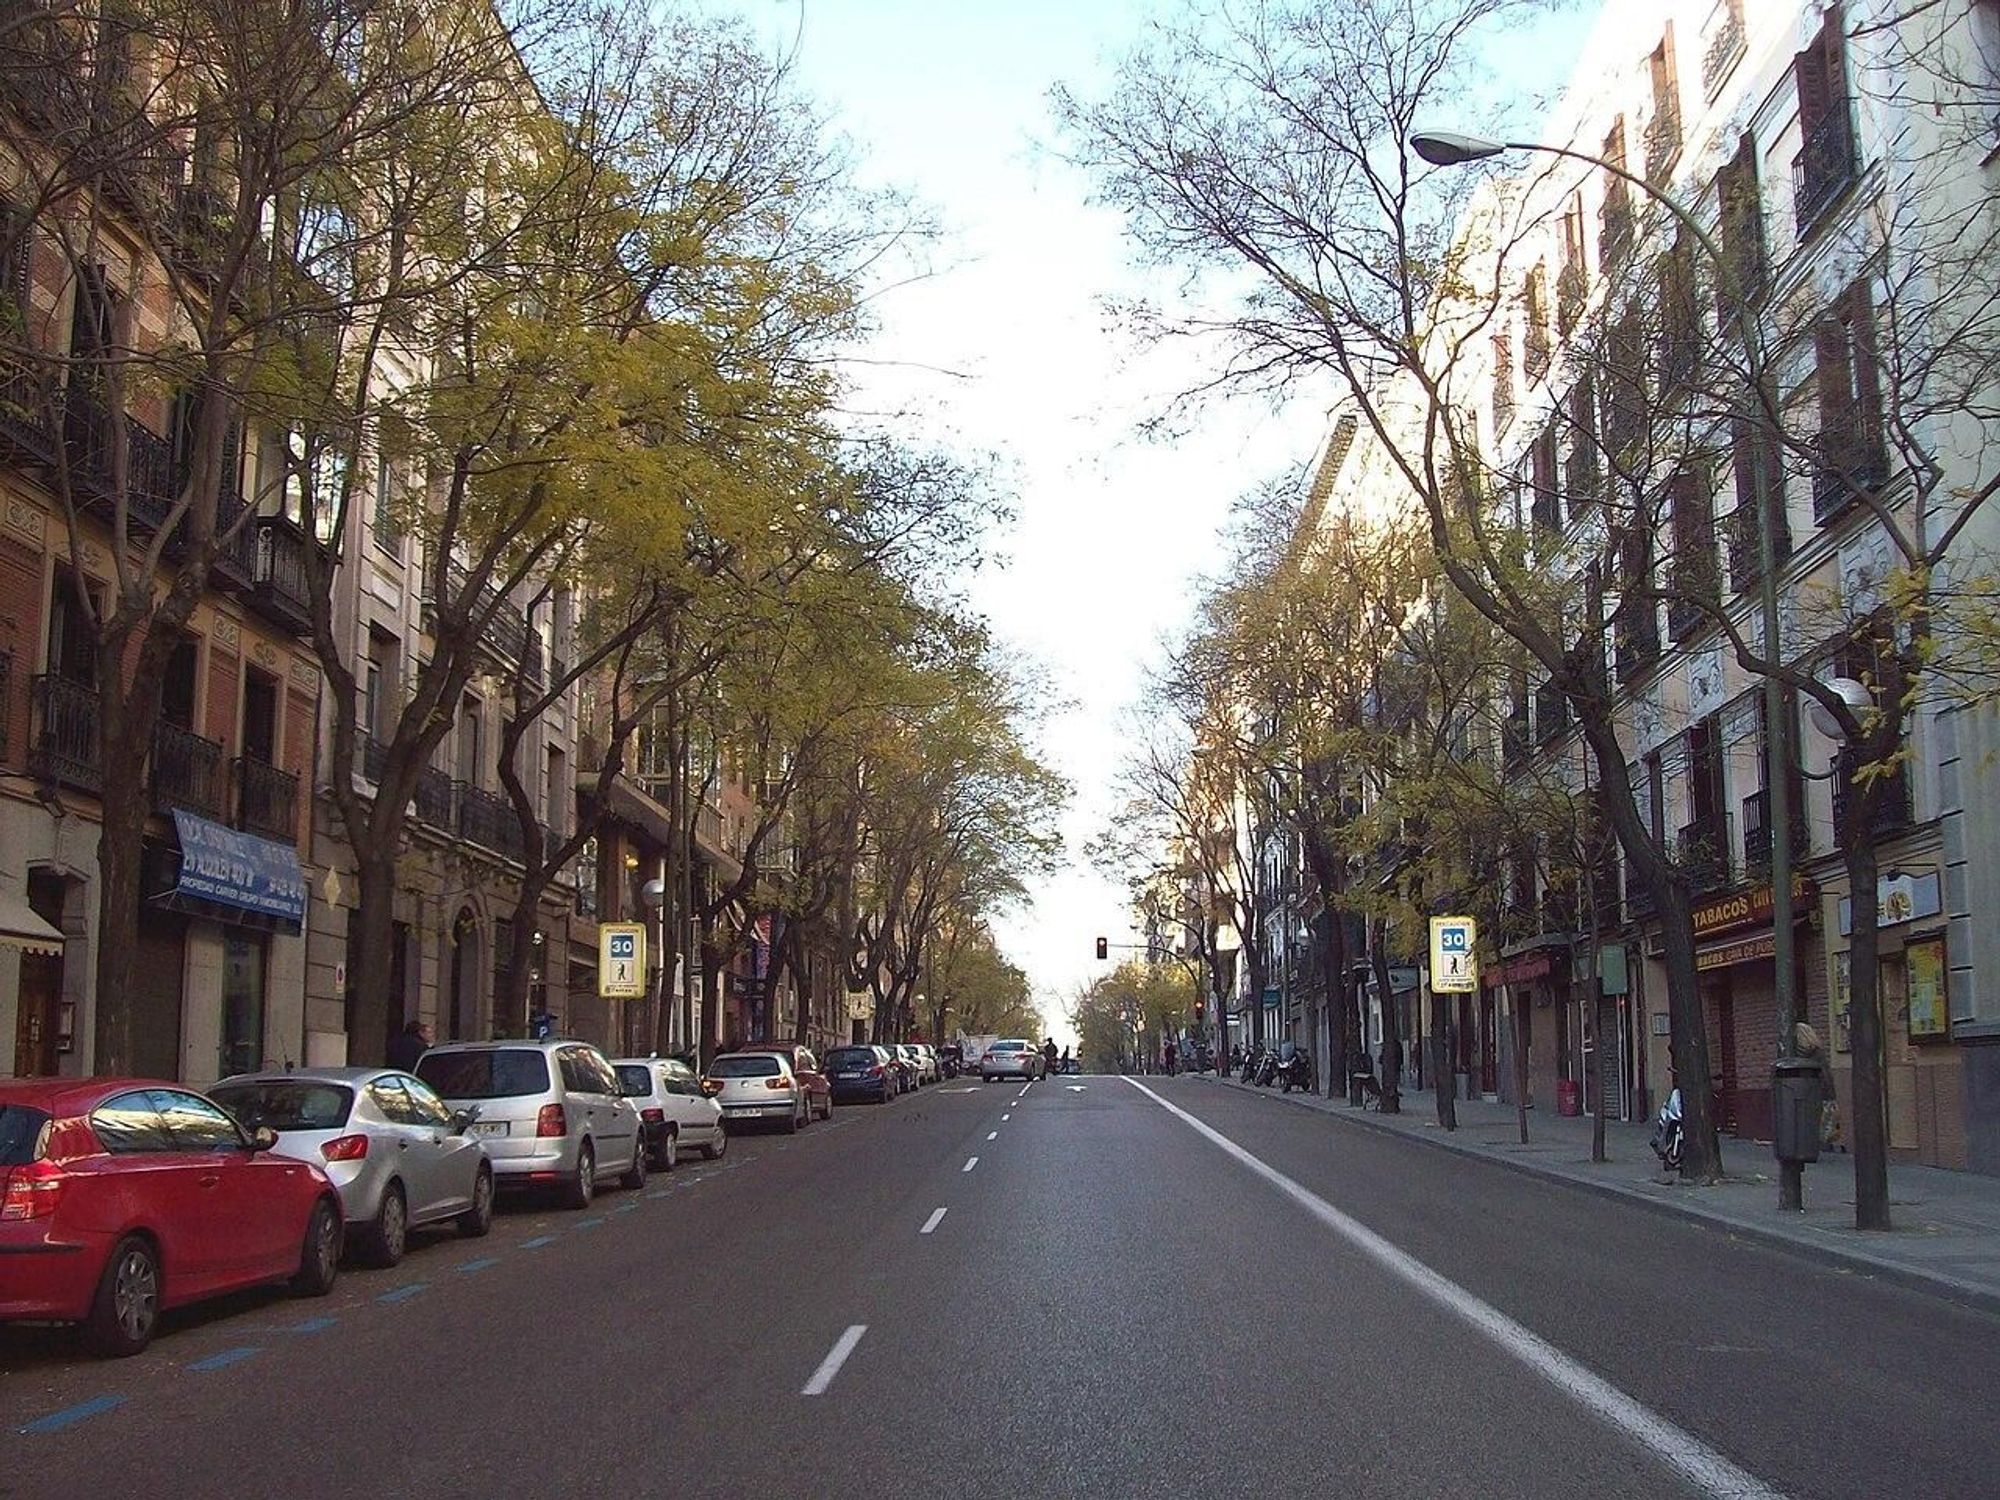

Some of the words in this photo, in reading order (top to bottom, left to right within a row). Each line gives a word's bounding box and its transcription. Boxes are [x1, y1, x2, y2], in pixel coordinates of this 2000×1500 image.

[1692, 897, 1748, 929] TABACOS
[611, 940, 633, 953] 30
[1443, 933, 1464, 947] 30
[539, 1026, 548, 1038] P
